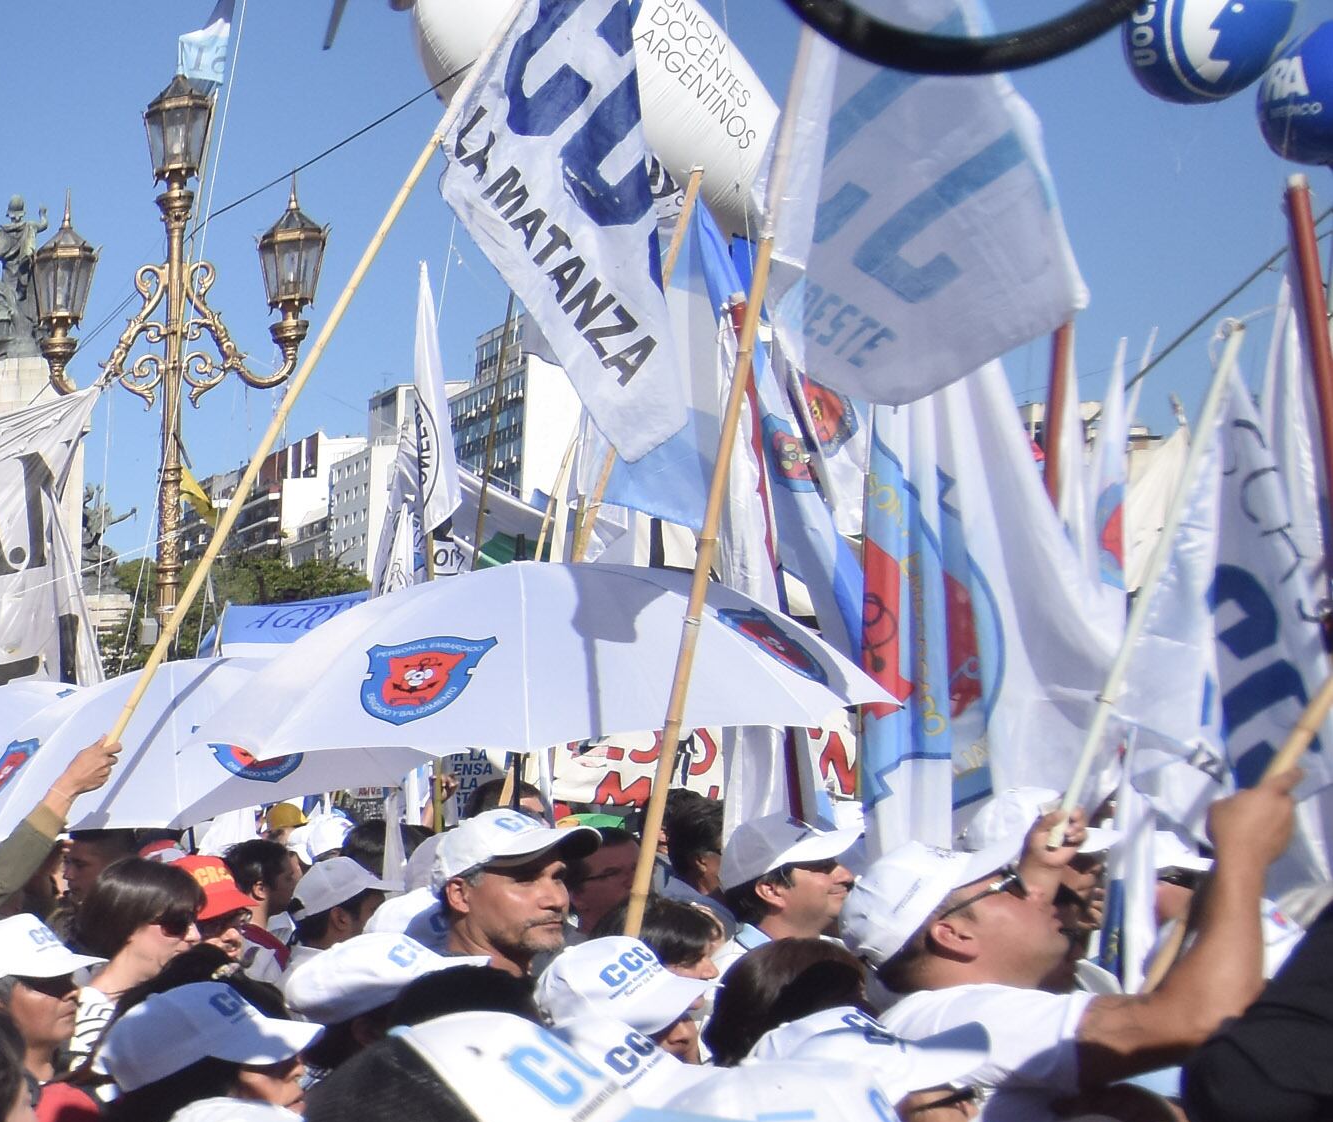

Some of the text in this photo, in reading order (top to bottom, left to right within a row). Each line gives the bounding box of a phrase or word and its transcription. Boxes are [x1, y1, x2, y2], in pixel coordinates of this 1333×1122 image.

[635, 29, 756, 149] ARGENTINOS
[650, 6, 751, 107] DOCENTES
[453, 104, 658, 387] LA MATANZA
[376, 642, 429, 658] PERSONAL
[460, 778, 478, 790] LA
[599, 946, 654, 988] CCC
